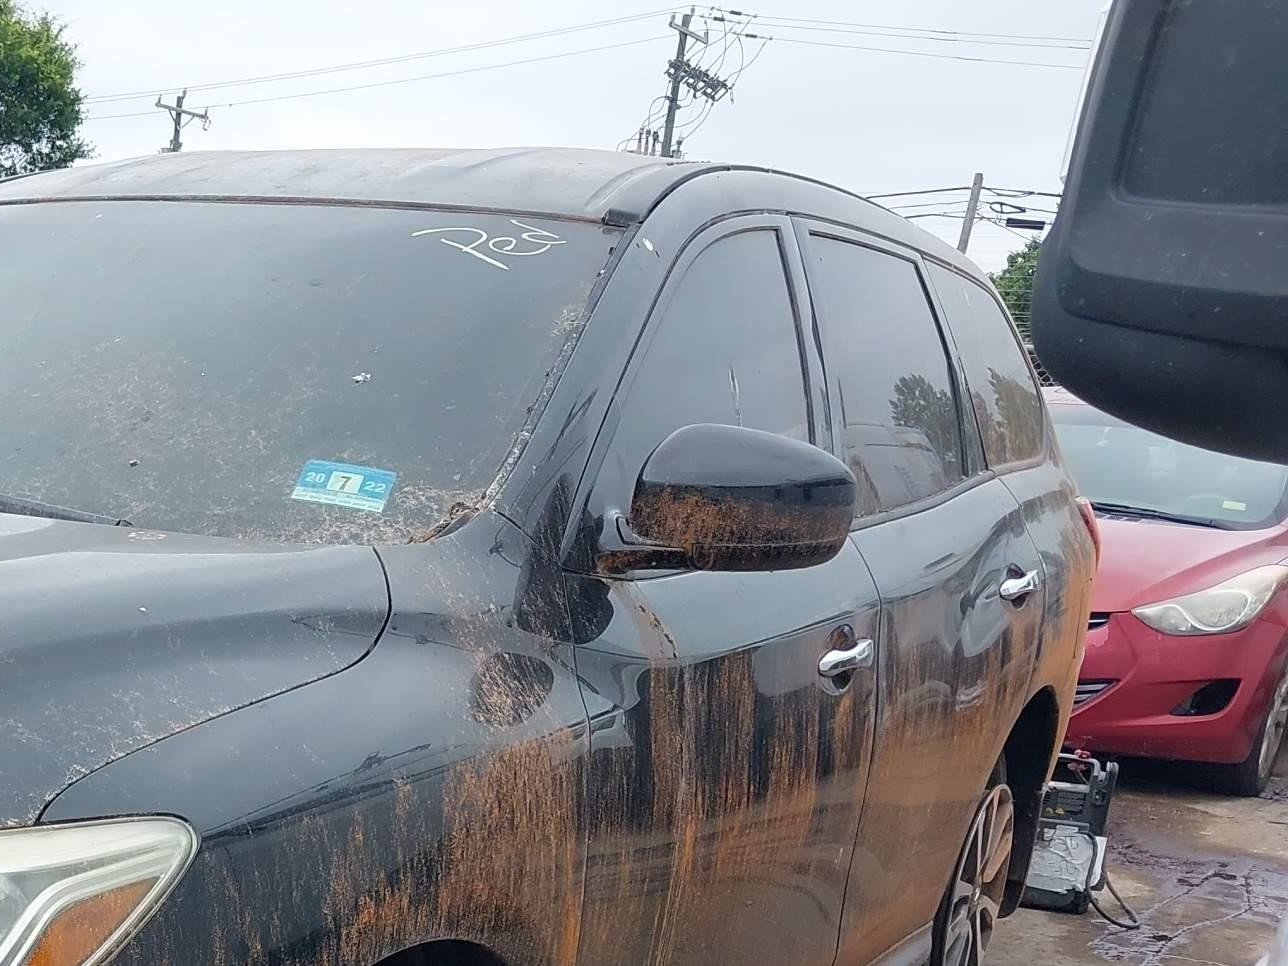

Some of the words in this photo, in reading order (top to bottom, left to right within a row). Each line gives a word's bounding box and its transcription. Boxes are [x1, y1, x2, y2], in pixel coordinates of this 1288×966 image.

[305, 472, 326, 483] 20
[338, 475, 353, 491] 7
[363, 481, 387, 493] 22
